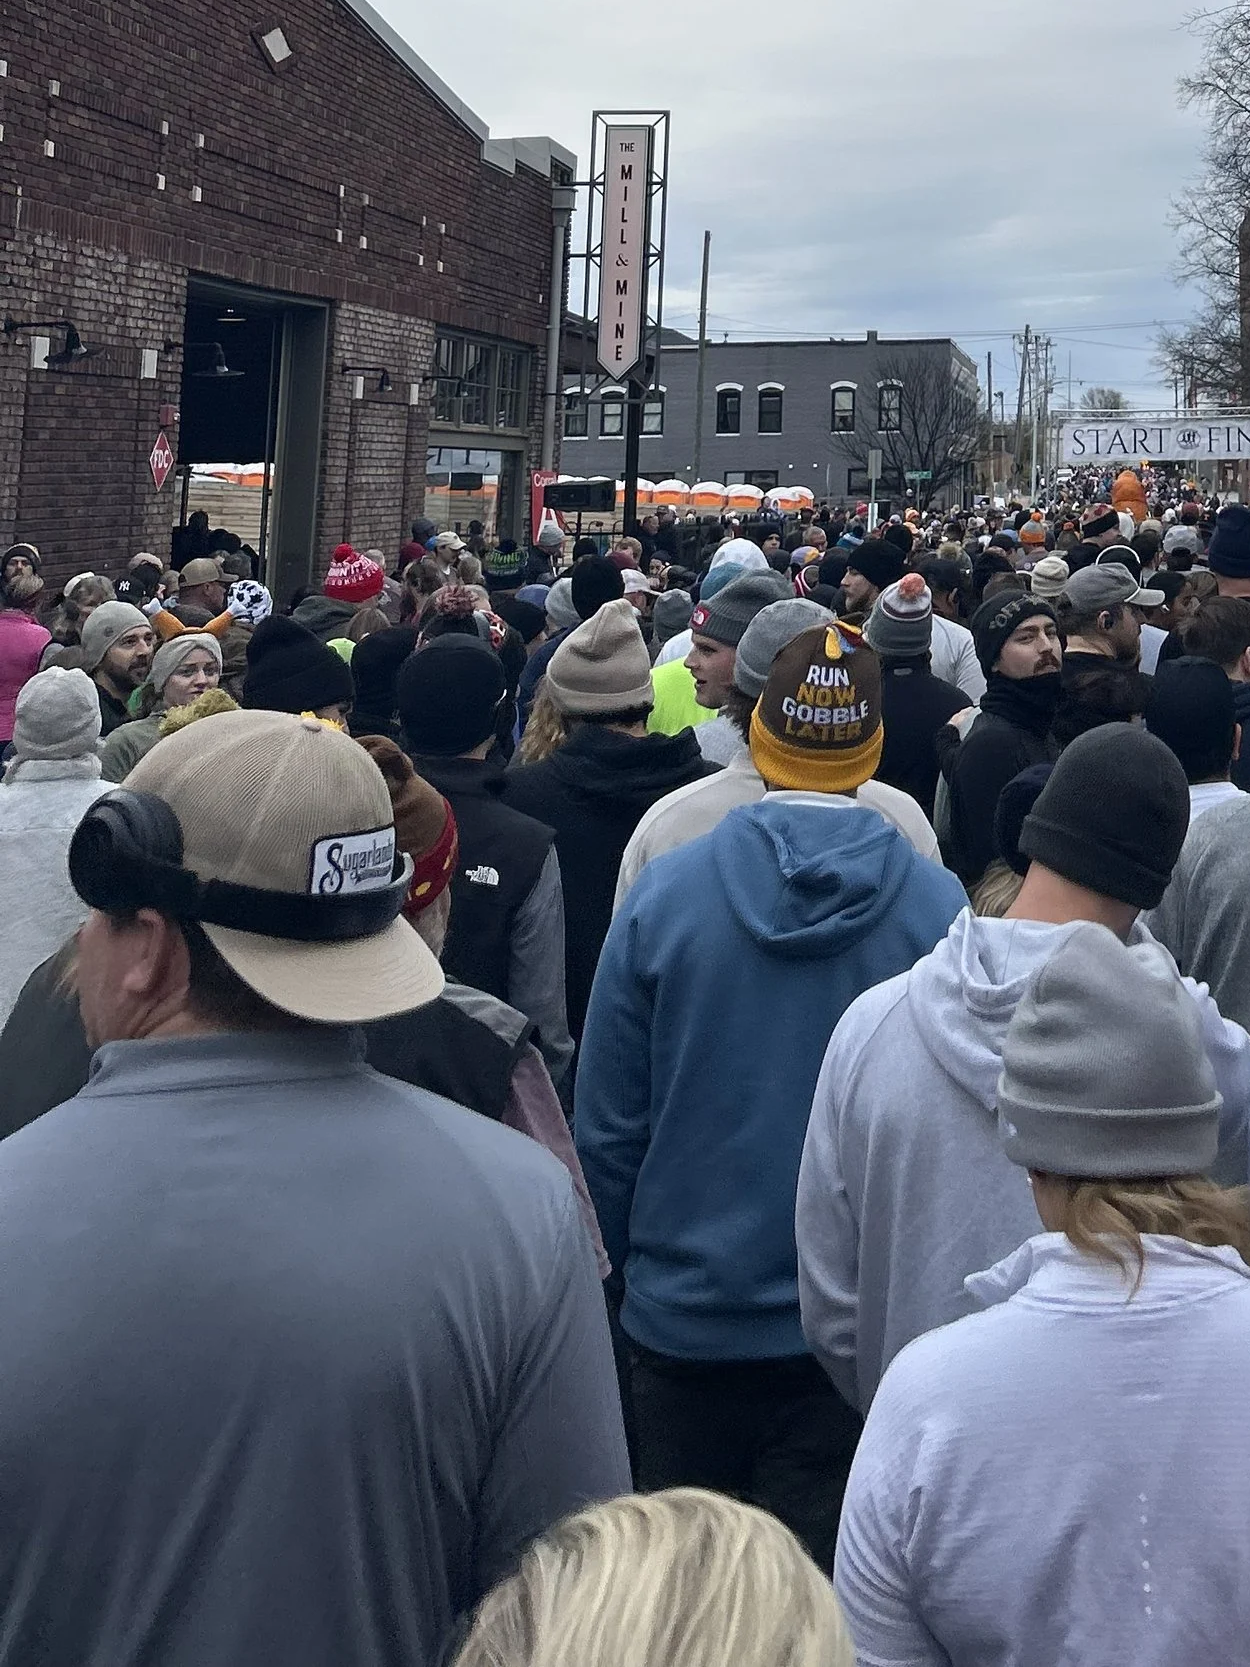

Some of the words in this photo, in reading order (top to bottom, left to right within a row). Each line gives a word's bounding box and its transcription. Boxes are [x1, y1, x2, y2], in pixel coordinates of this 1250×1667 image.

[619, 142, 635, 153] THE
[620, 164, 633, 245] MILL
[615, 253, 629, 267] &
[615, 279, 628, 361] MINE
[1072, 427, 1172, 456] START
[153, 449, 170, 469] FDC
[806, 664, 850, 687] RUN
[796, 682, 856, 707] NOW
[781, 696, 869, 725] GOBBLE
[784, 716, 862, 742] LATER
